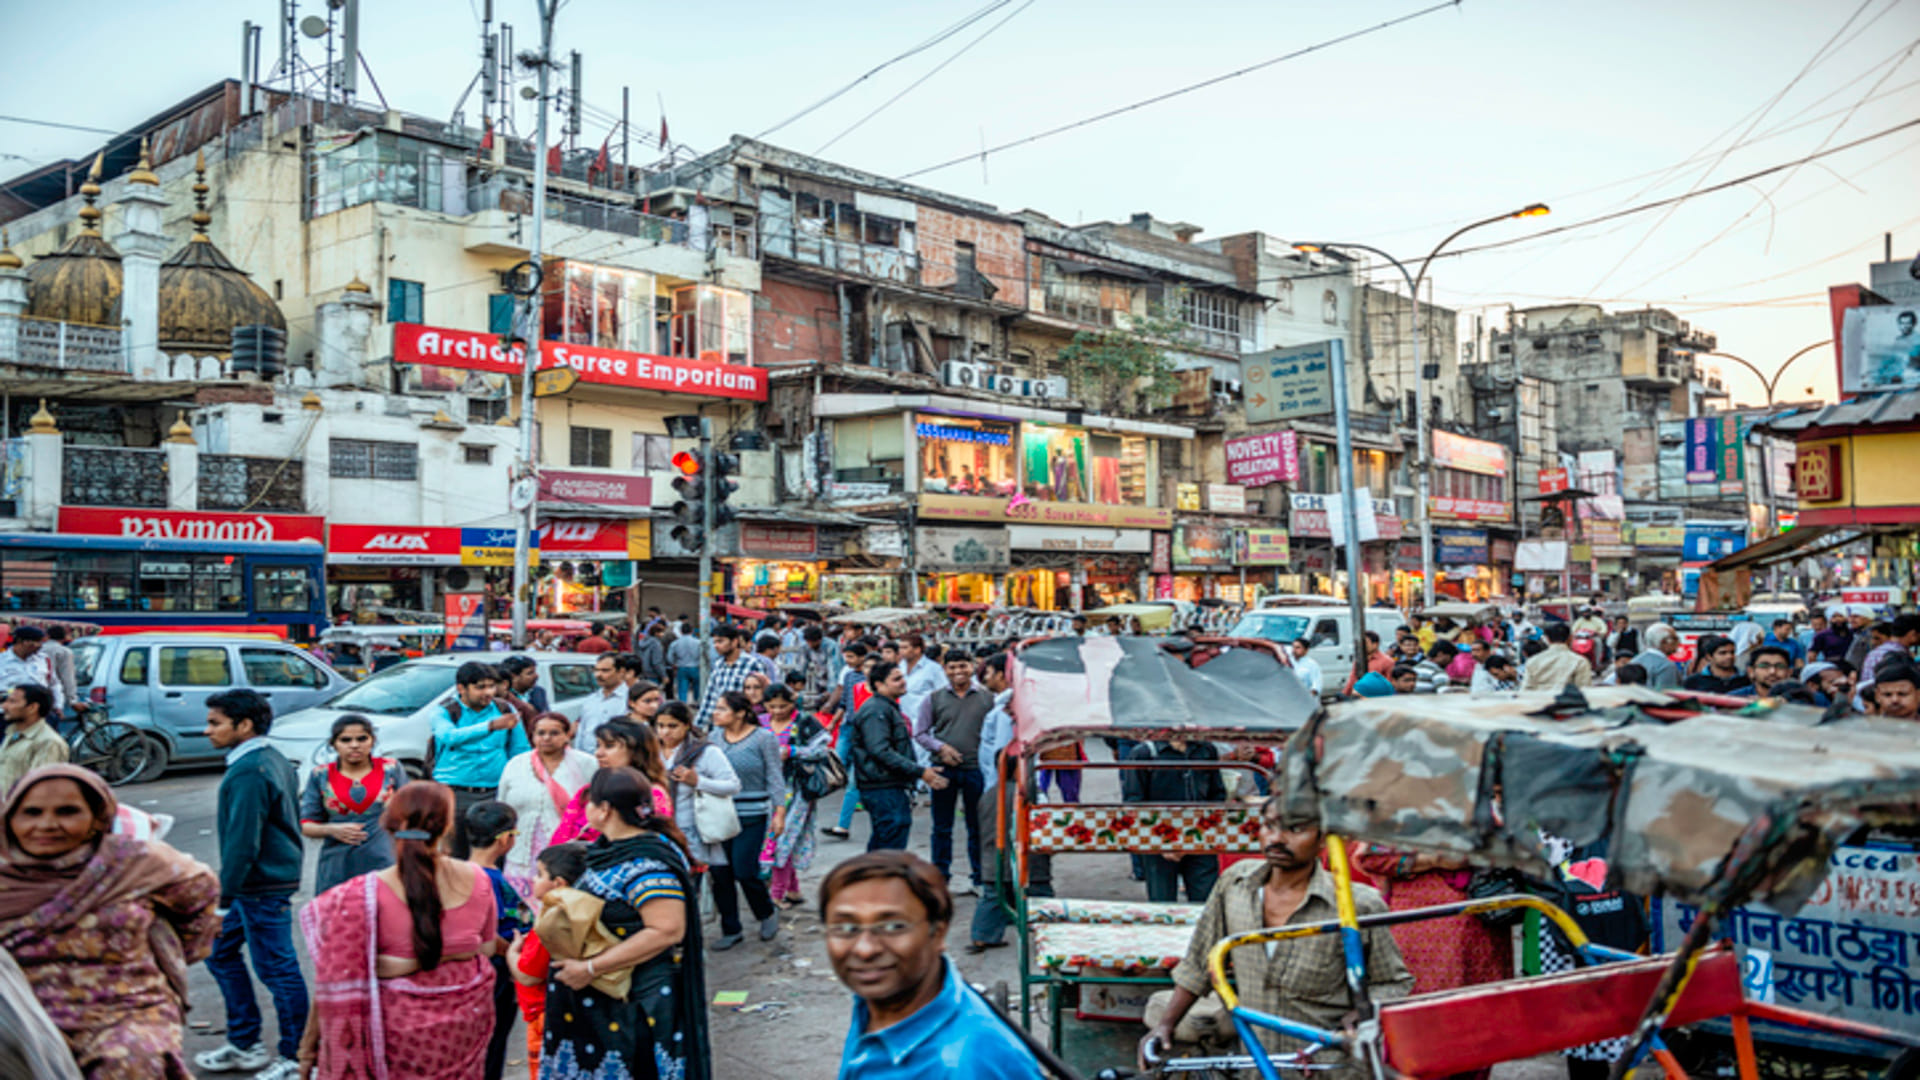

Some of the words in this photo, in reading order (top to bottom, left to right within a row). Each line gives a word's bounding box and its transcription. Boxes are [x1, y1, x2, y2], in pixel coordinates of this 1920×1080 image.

[553, 348, 628, 376] Saree
[637, 358, 757, 391] Emporium
[1227, 436, 1279, 461] NOVELTY
[1231, 456, 1280, 477] CREATION
[550, 486, 627, 500] TOURISTER
[551, 478, 627, 491] AMERICAN
[363, 532, 430, 550] ALFA
[552, 521, 601, 541] VIP
